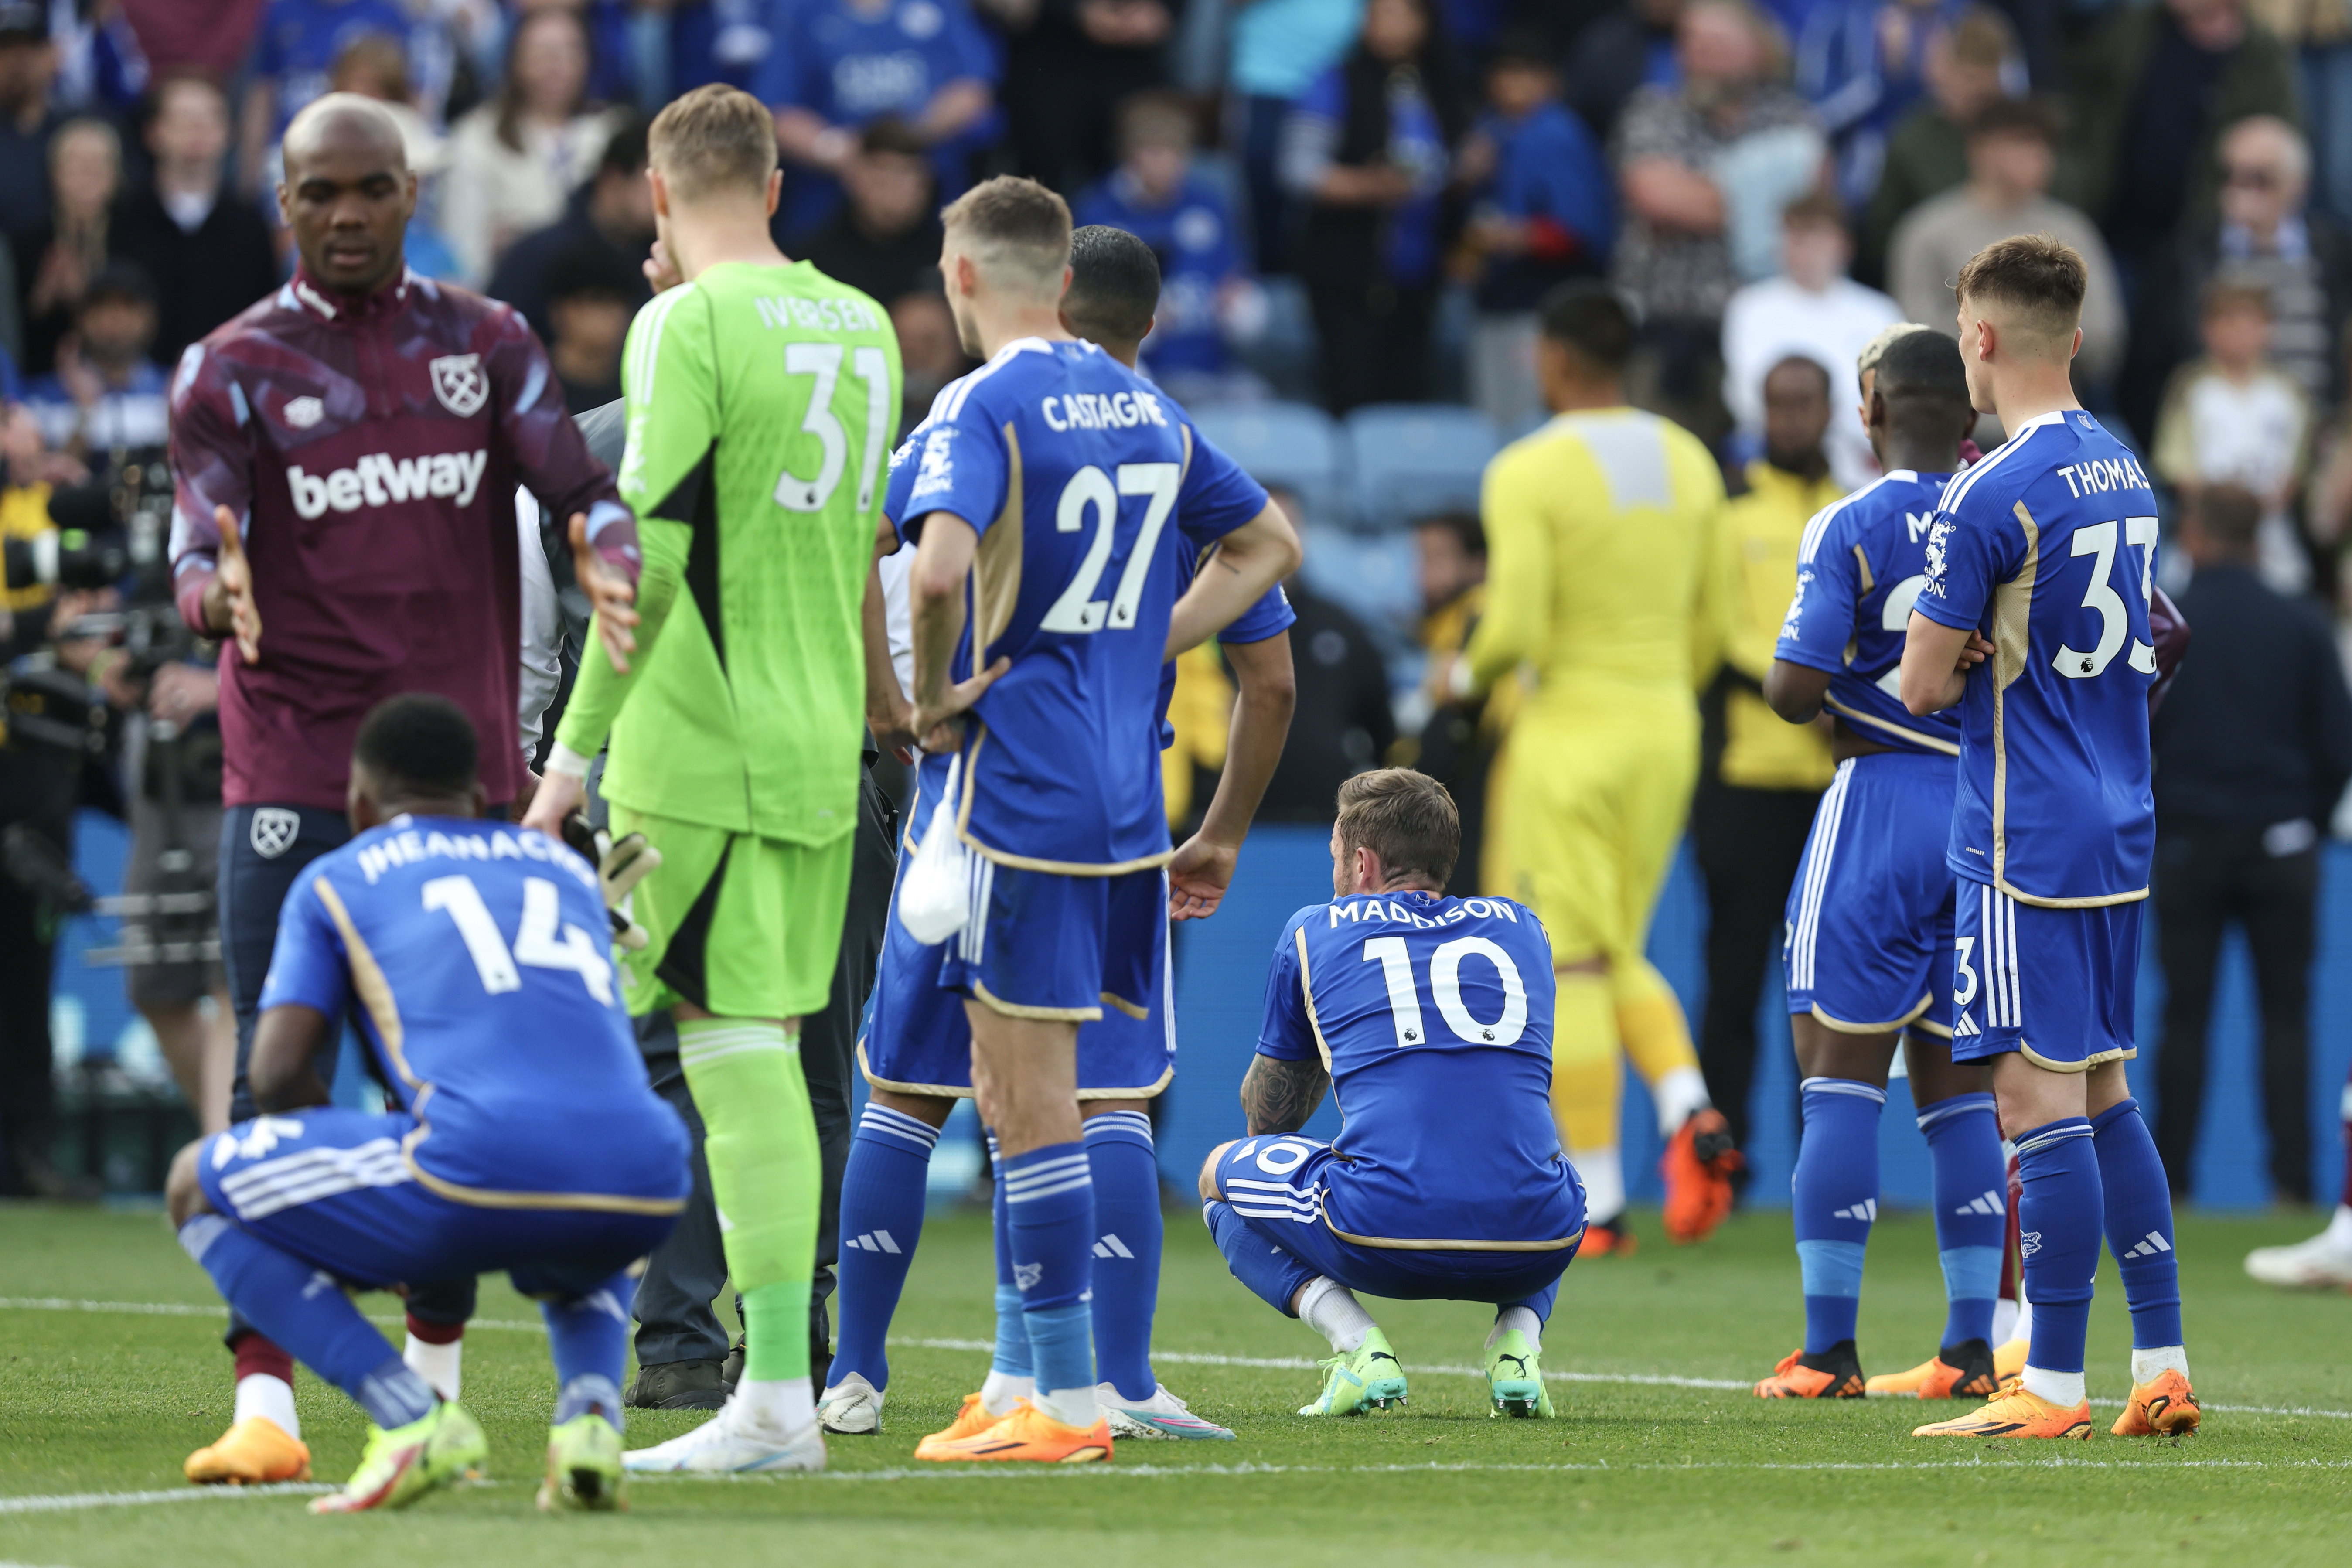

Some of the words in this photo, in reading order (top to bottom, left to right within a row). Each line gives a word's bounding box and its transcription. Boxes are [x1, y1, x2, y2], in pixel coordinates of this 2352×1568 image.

[773, 342, 890, 513] 31
[1041, 390, 1168, 432] CASTAGNE
[286, 447, 488, 520] betway
[2056, 457, 2151, 498] THOMAS
[1039, 463, 1181, 634] 27
[1966, 846, 1985, 856] AEROREADY
[421, 874, 615, 1008] 14
[1329, 899, 1517, 929] MADDISON
[1362, 935, 1528, 1048] 10
